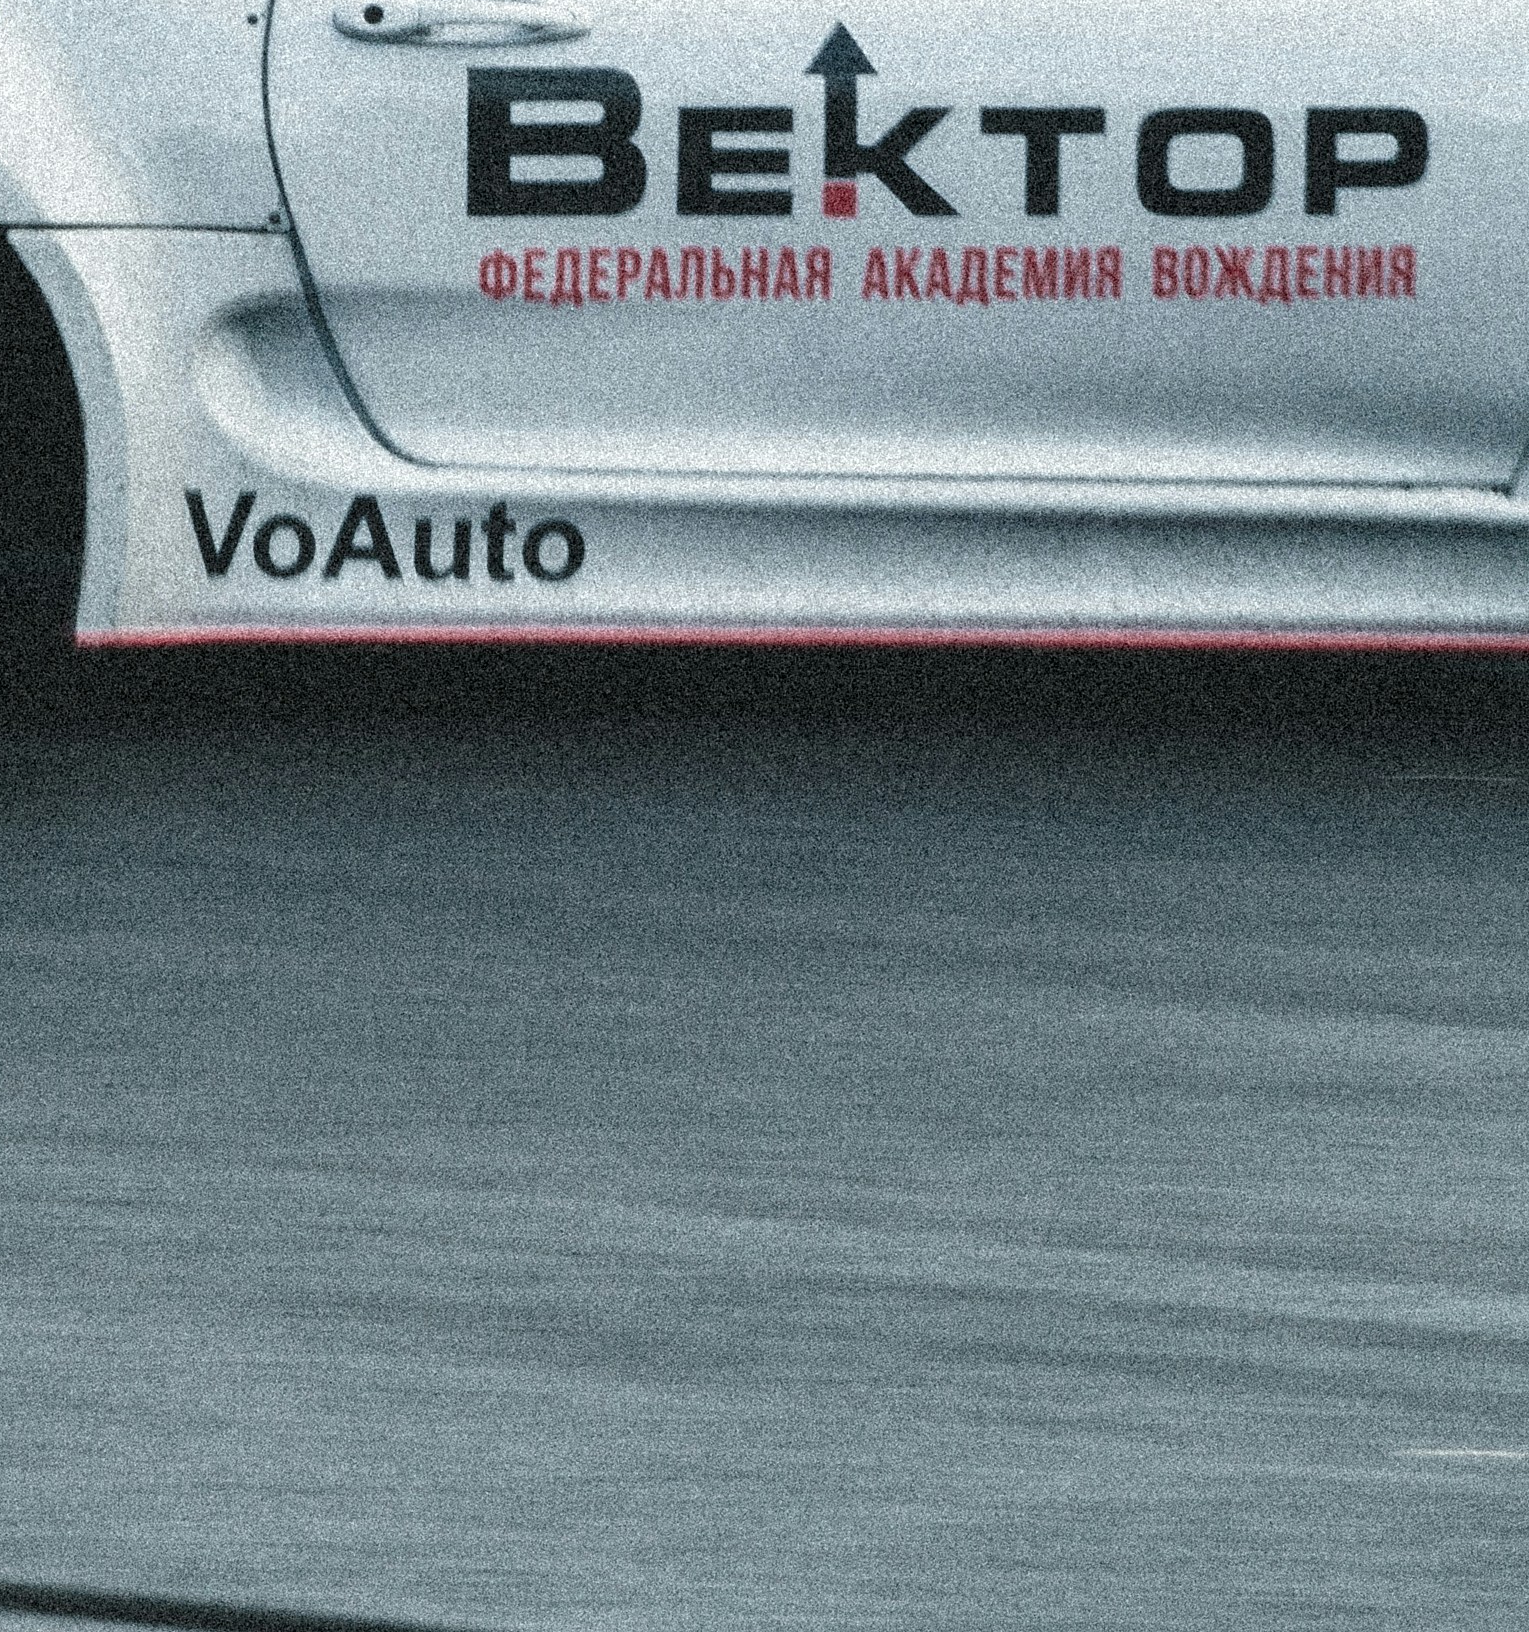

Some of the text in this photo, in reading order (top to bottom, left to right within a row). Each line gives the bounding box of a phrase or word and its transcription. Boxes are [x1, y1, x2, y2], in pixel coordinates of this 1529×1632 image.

[478, 245, 1418, 308] ФЕДЕРАЛЬНАЯ АКАДЕМИЯ ВОЖДЕНИЯ
[184, 487, 586, 582] VoAuto
